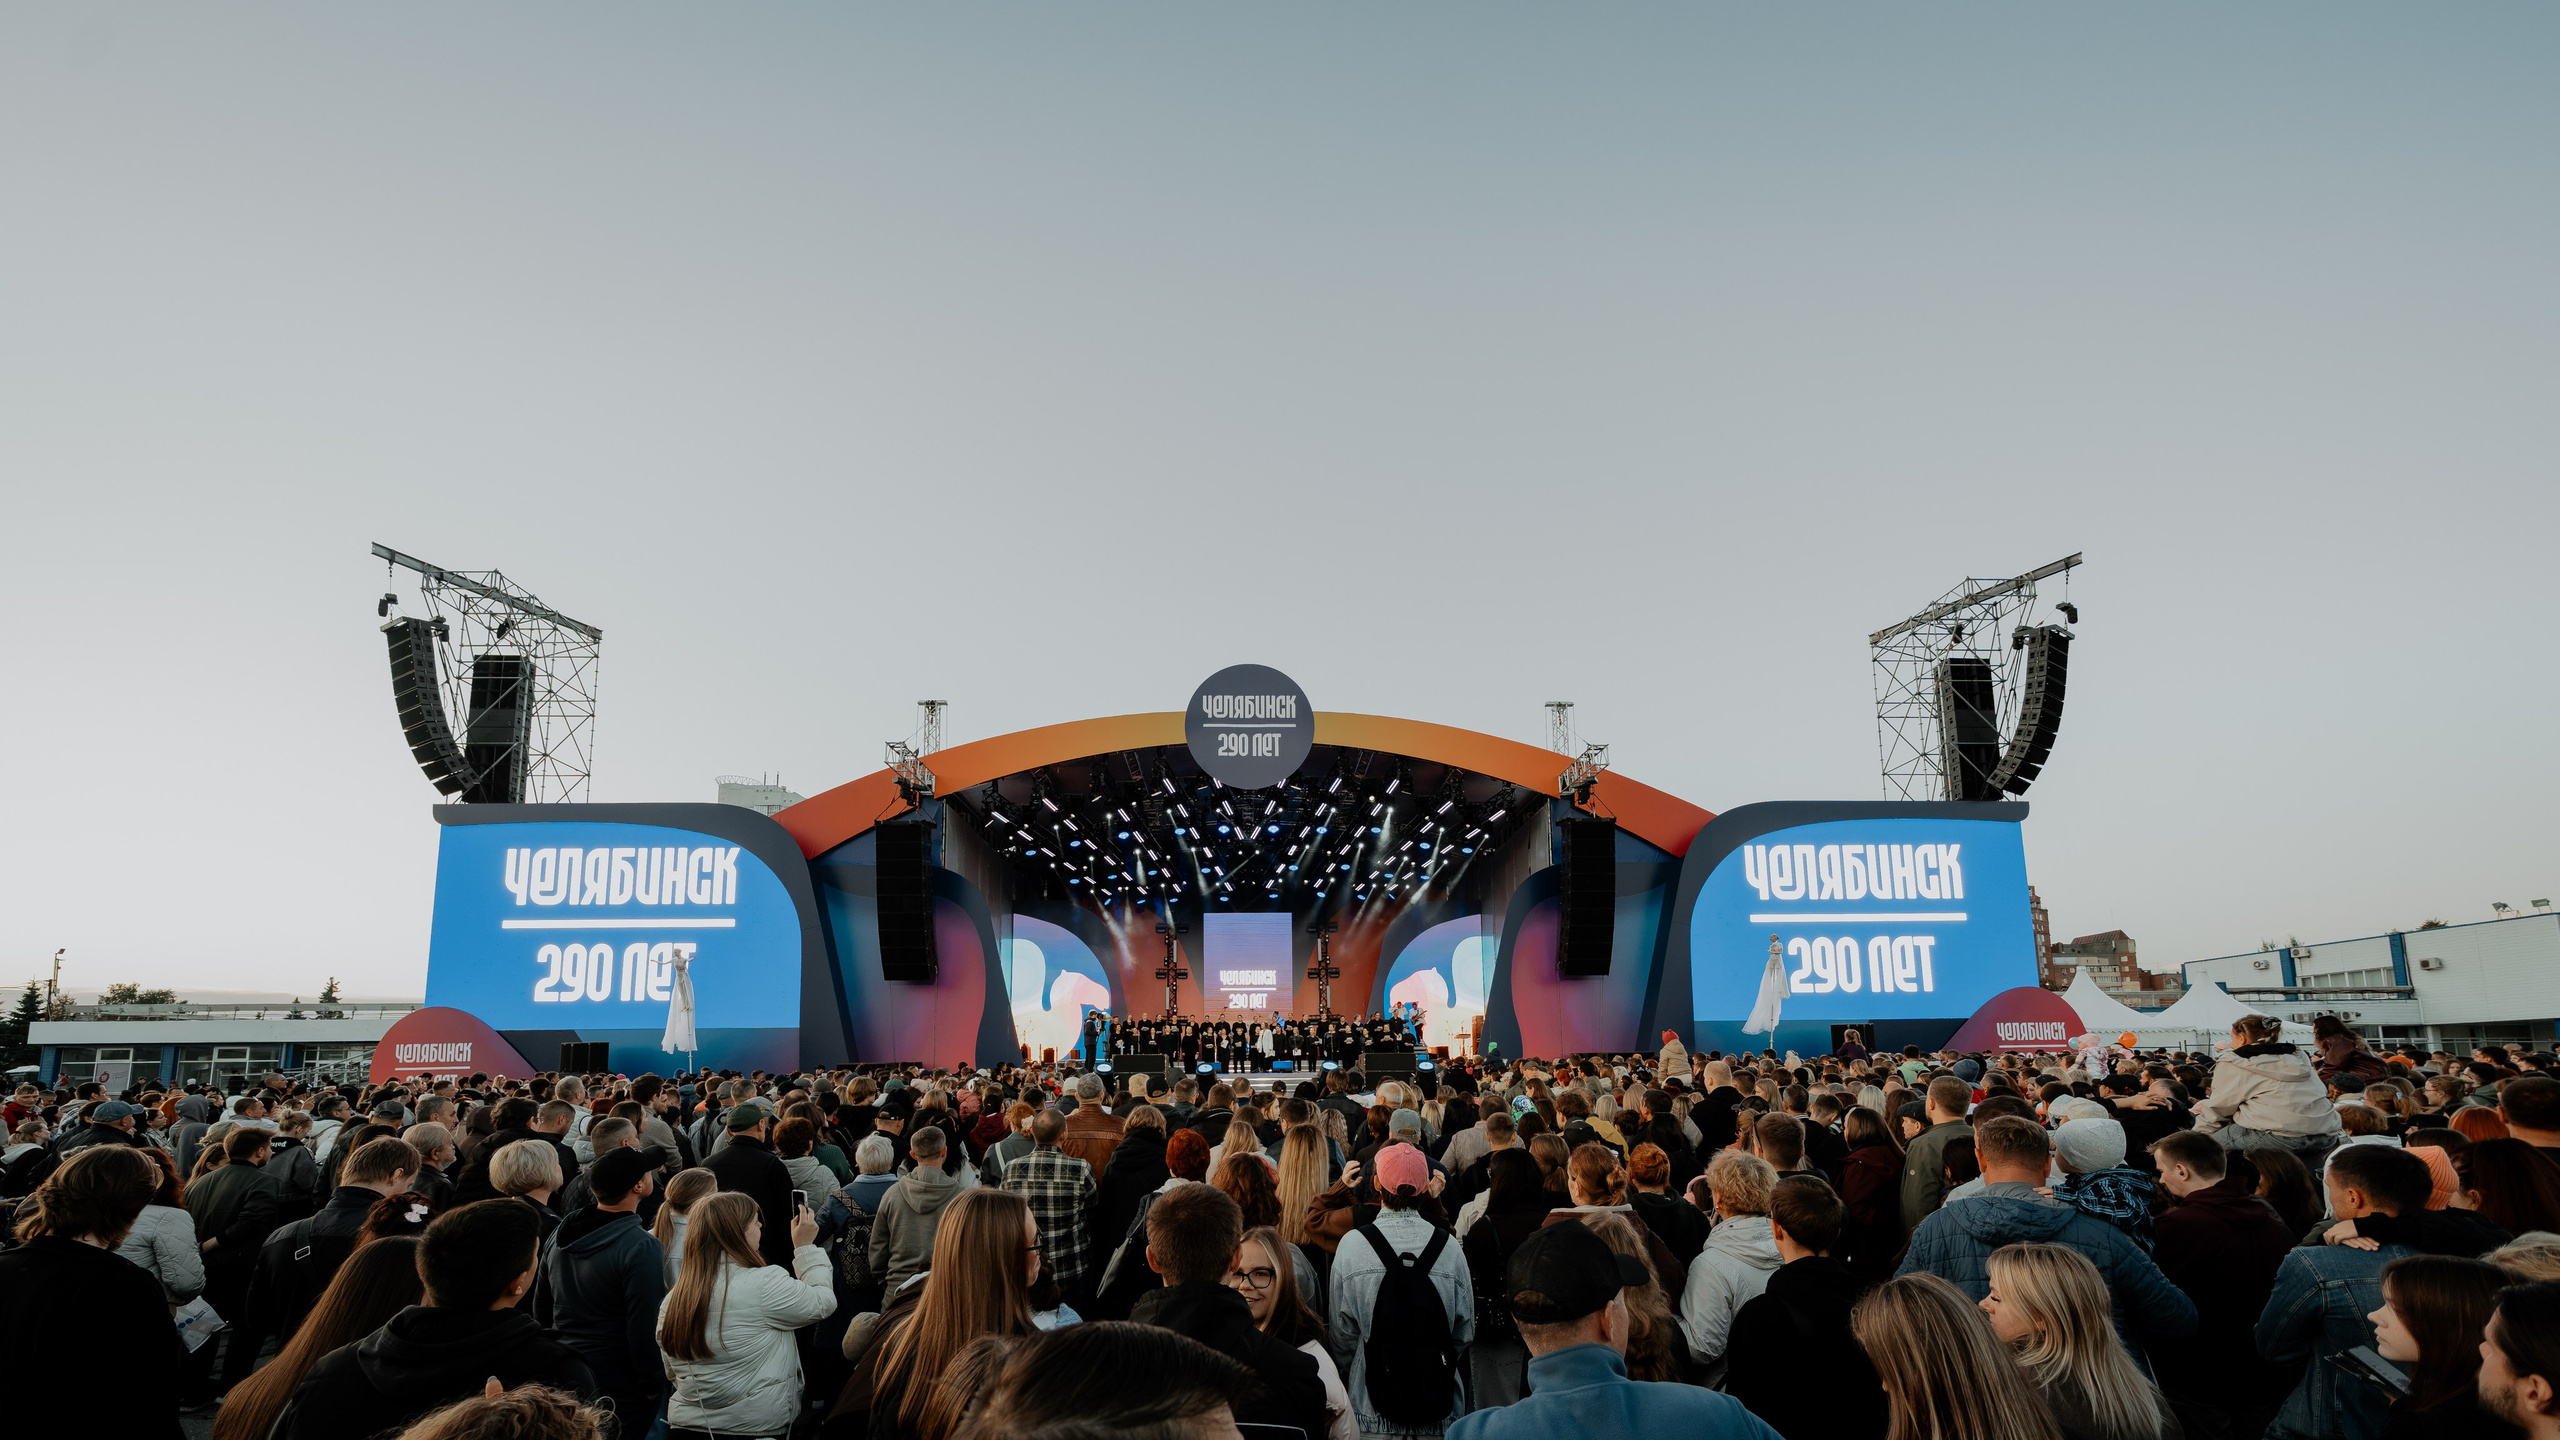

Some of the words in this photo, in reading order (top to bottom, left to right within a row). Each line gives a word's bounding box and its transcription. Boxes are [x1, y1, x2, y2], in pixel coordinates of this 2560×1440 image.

[1203, 695, 1296, 718] ЧЕЛЯБИНСК
[1218, 733, 1248, 757] 290
[1253, 733, 1281, 757] ЛЕТ
[505, 847, 740, 905] ЧЕЛЯБИНСК
[1744, 844, 1963, 900] ЧЕЛЯБИНСК
[534, 943, 613, 1002] 290
[1788, 937, 1861, 993] 290
[1868, 936, 1935, 992] ЛЕТ
[1229, 994, 1248, 1008] 290
[1997, 1022, 2066, 1041] ЧЕЛЯБИНСК
[395, 1042, 472, 1063] ЧЕЛЯБИНСК
